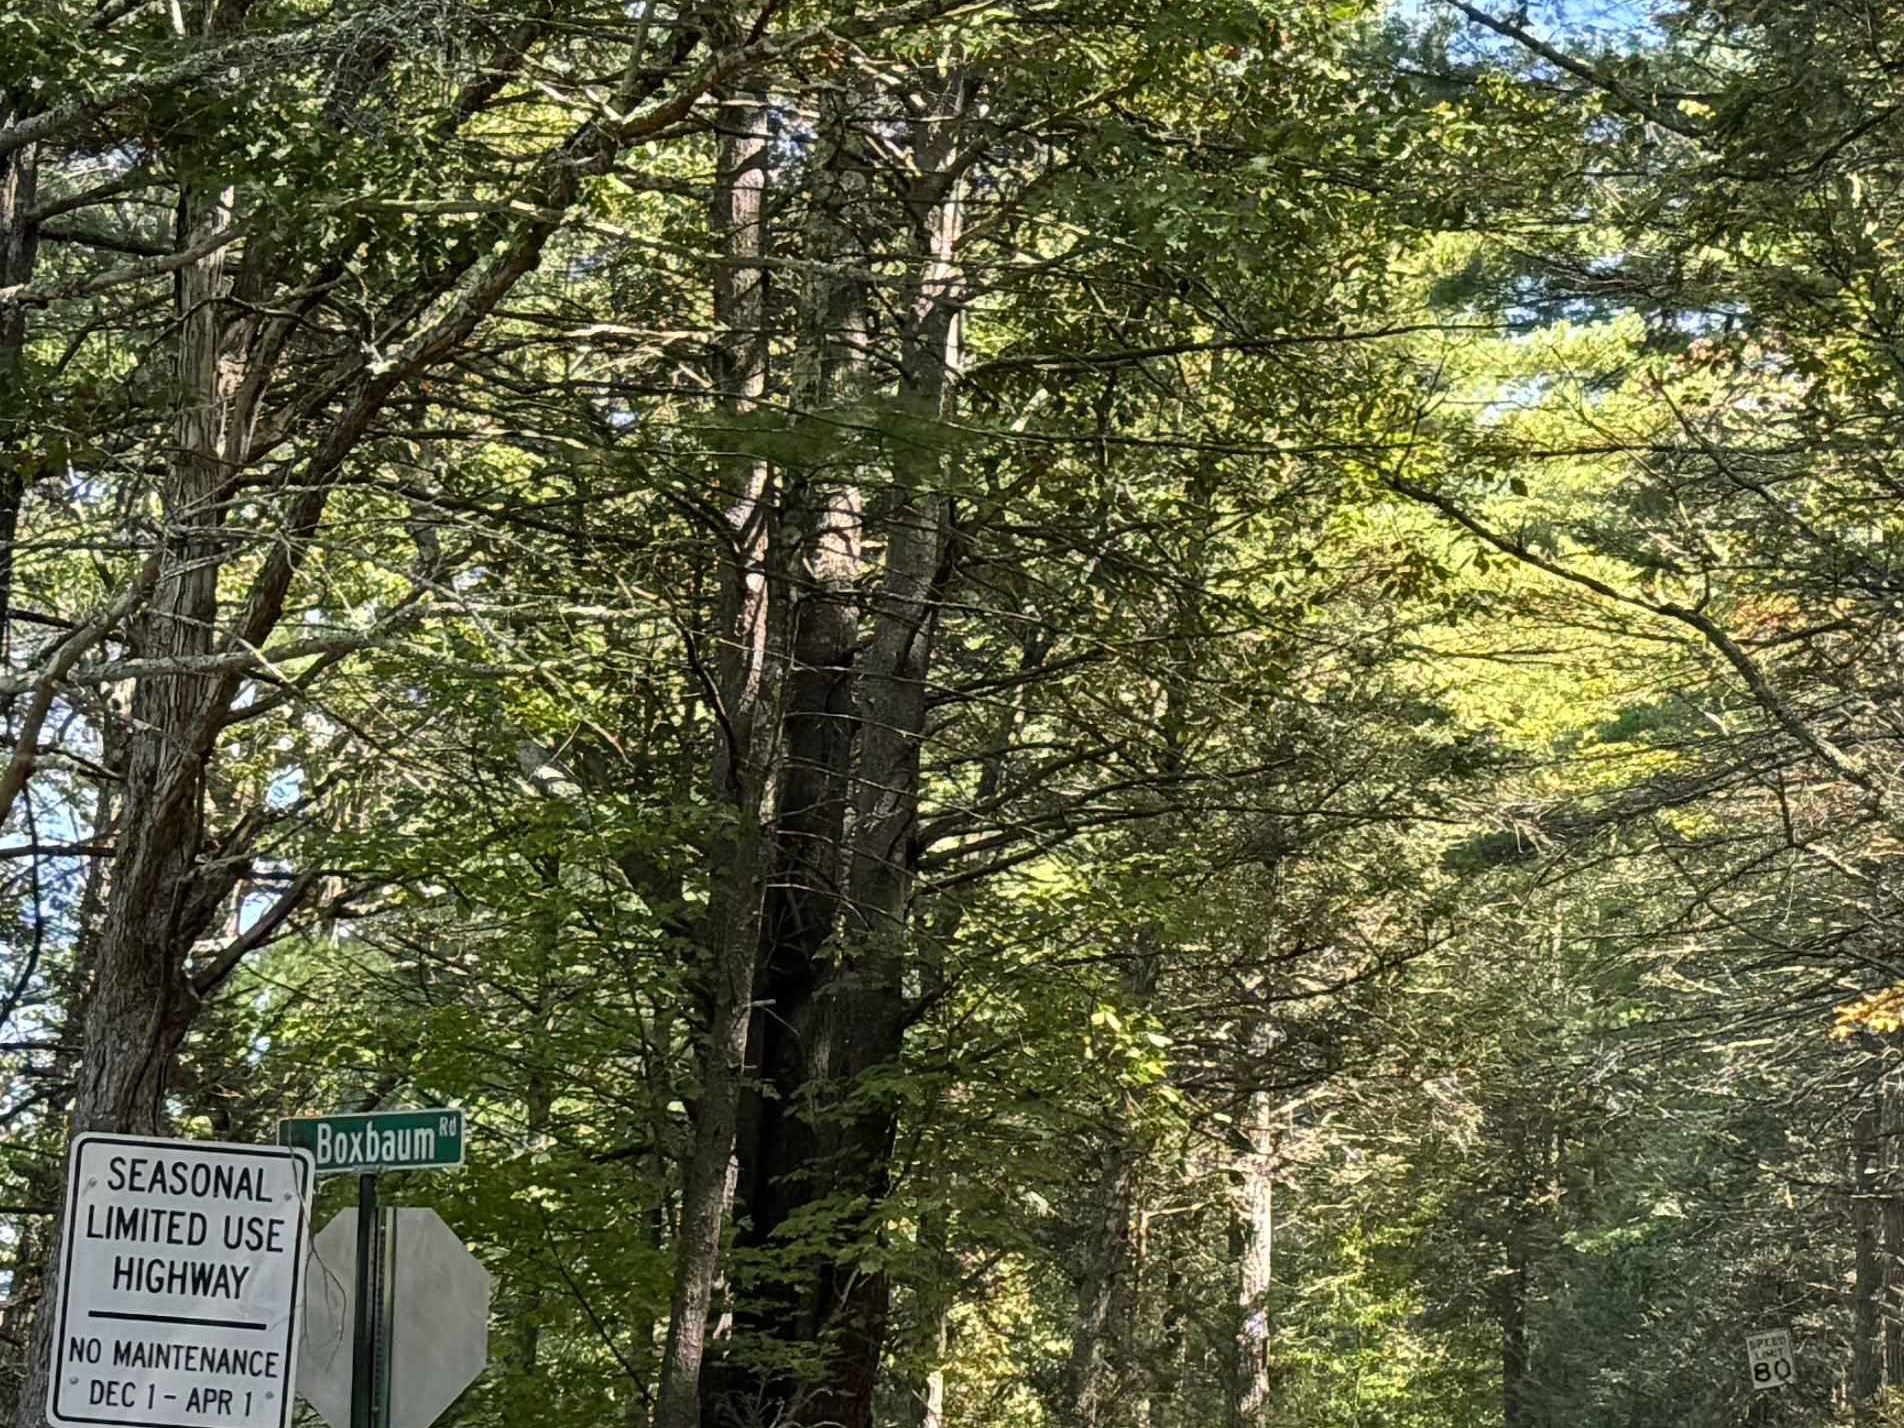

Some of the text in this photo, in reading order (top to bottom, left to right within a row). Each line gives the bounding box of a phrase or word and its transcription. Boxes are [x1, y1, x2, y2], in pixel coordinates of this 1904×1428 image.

[317, 1116, 457, 1164] Boxbaum Rd
[107, 1156, 272, 1202] SEASONAL
[86, 1204, 285, 1252] LIMITED USE
[113, 1255, 249, 1299] HIGHWAY
[69, 1336, 279, 1378] NO MAINTENANCE
[89, 1379, 136, 1408] DEC
[147, 1383, 156, 1410] 1
[185, 1387, 233, 1416] APR
[245, 1391, 253, 1417] 1
